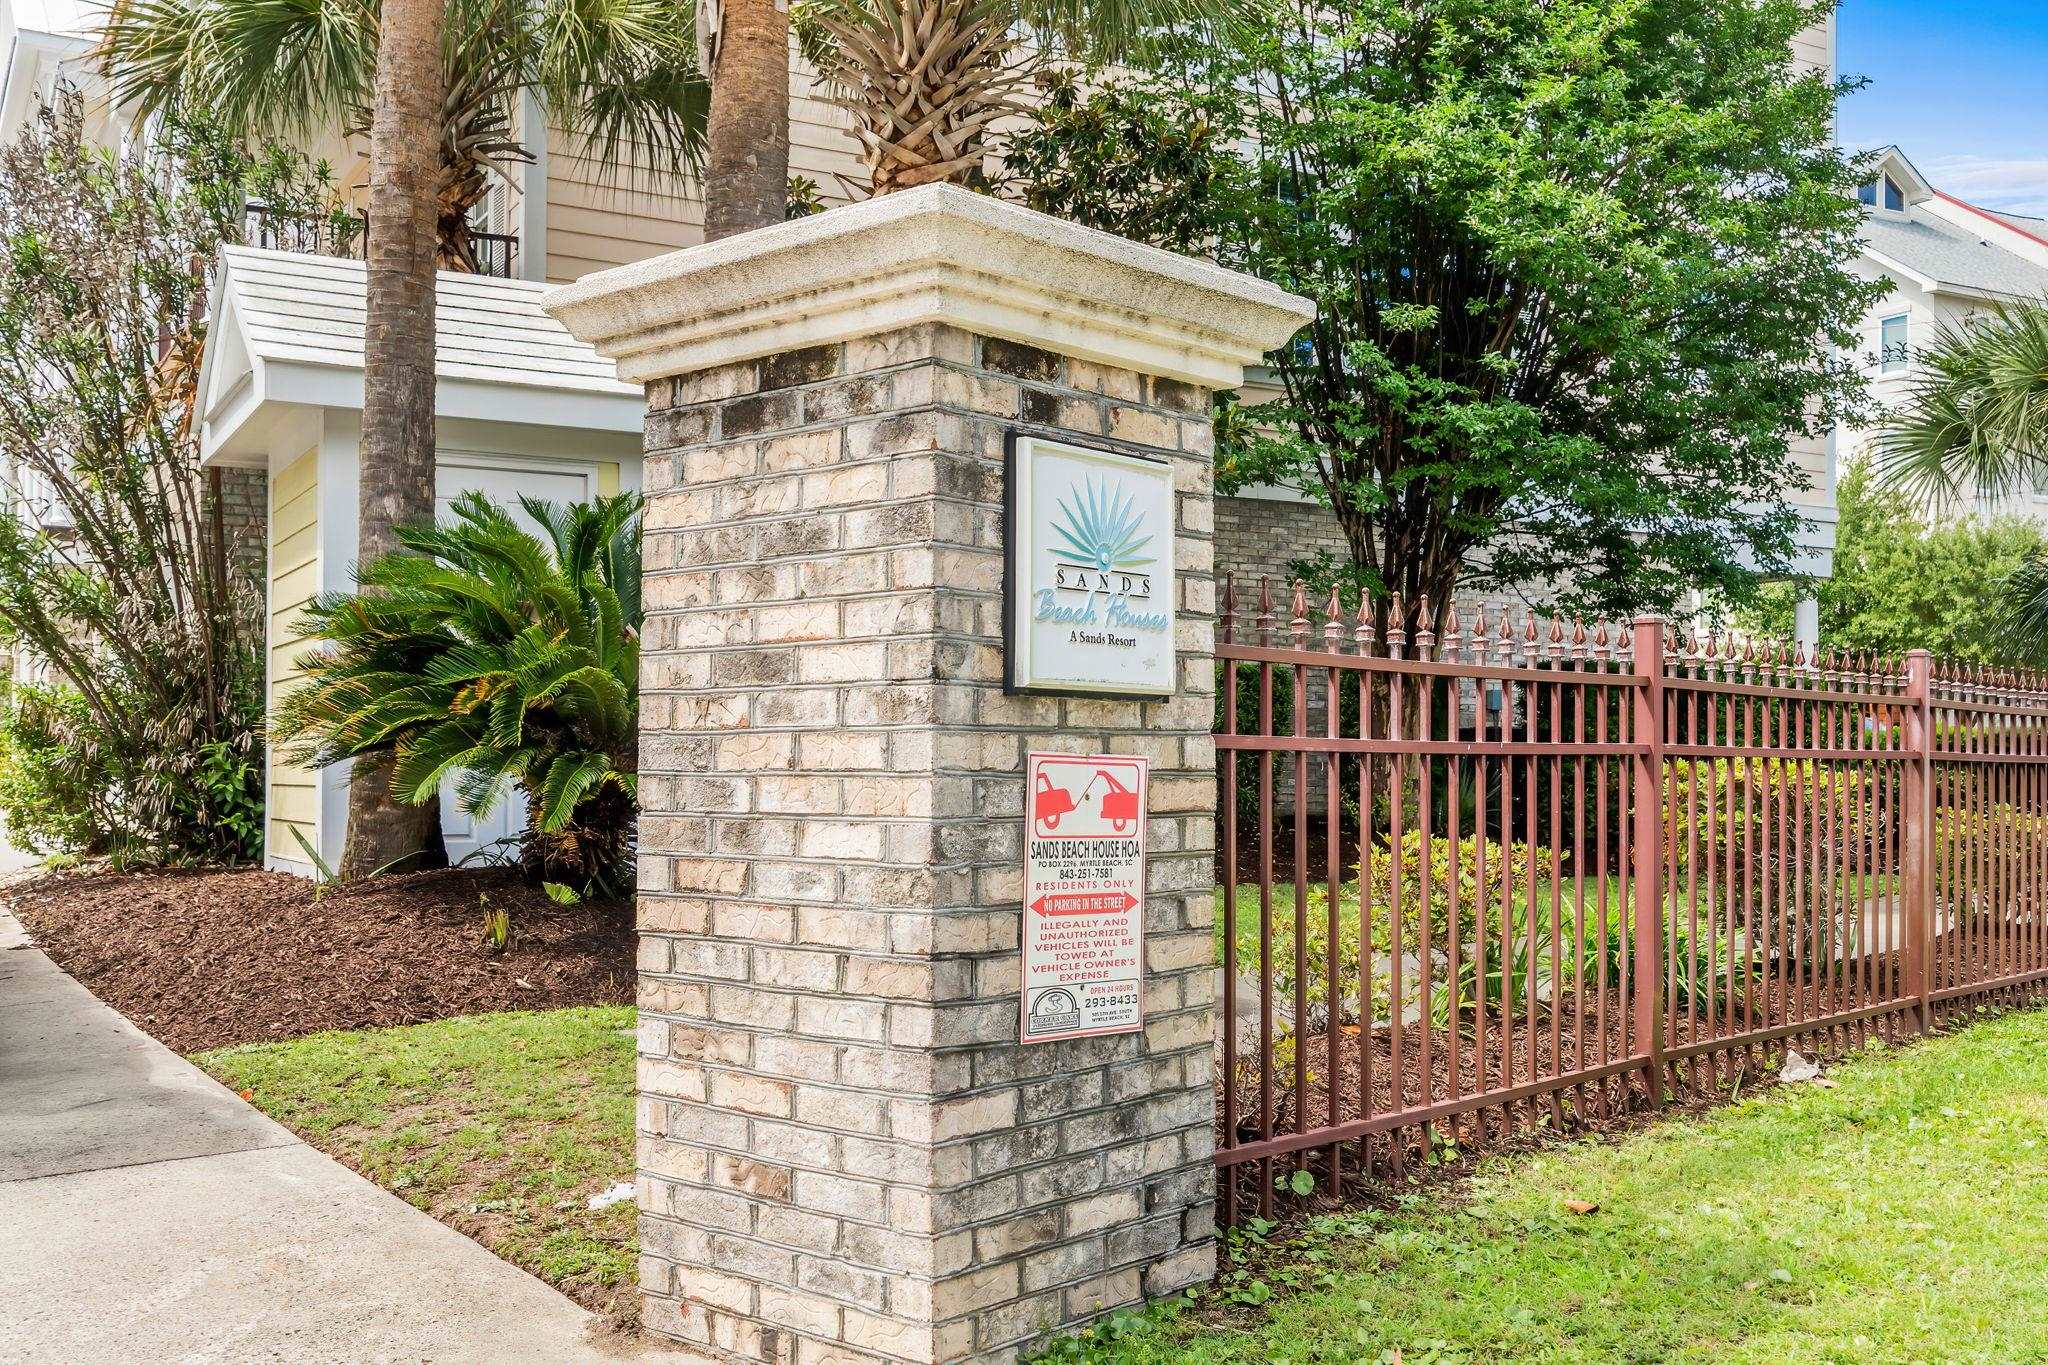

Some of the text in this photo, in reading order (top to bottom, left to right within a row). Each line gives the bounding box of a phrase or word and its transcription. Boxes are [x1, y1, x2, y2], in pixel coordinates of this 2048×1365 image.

[1056, 568, 1150, 594] SANDS
[1033, 588, 1168, 630] Beach Houses
[1069, 630, 1136, 647] A Sands Resort
[1031, 841, 1140, 859] SANDS BEACH HOUSE HOA
[1059, 868, 1113, 879] 843-251-7581
[1035, 879, 1134, 891] RESIDENTS ONLY
[1043, 896, 1126, 912] NO PARKING IN THE STREET
[1040, 918, 1128, 930] ILLEGALLY AND
[1040, 928, 1128, 940] UNAUTHORIZED
[1034, 938, 1134, 951] VEHICLES WILL BE
[1055, 949, 1114, 960] TOWED AT
[1032, 958, 1136, 973] VEHICLE OWNER'S
[1059, 970, 1109, 981] EXPENSE
[1090, 986, 1106, 994] OPEN
[1115, 984, 1133, 992] HOURS
[1085, 994, 1138, 1008] 293-8433
